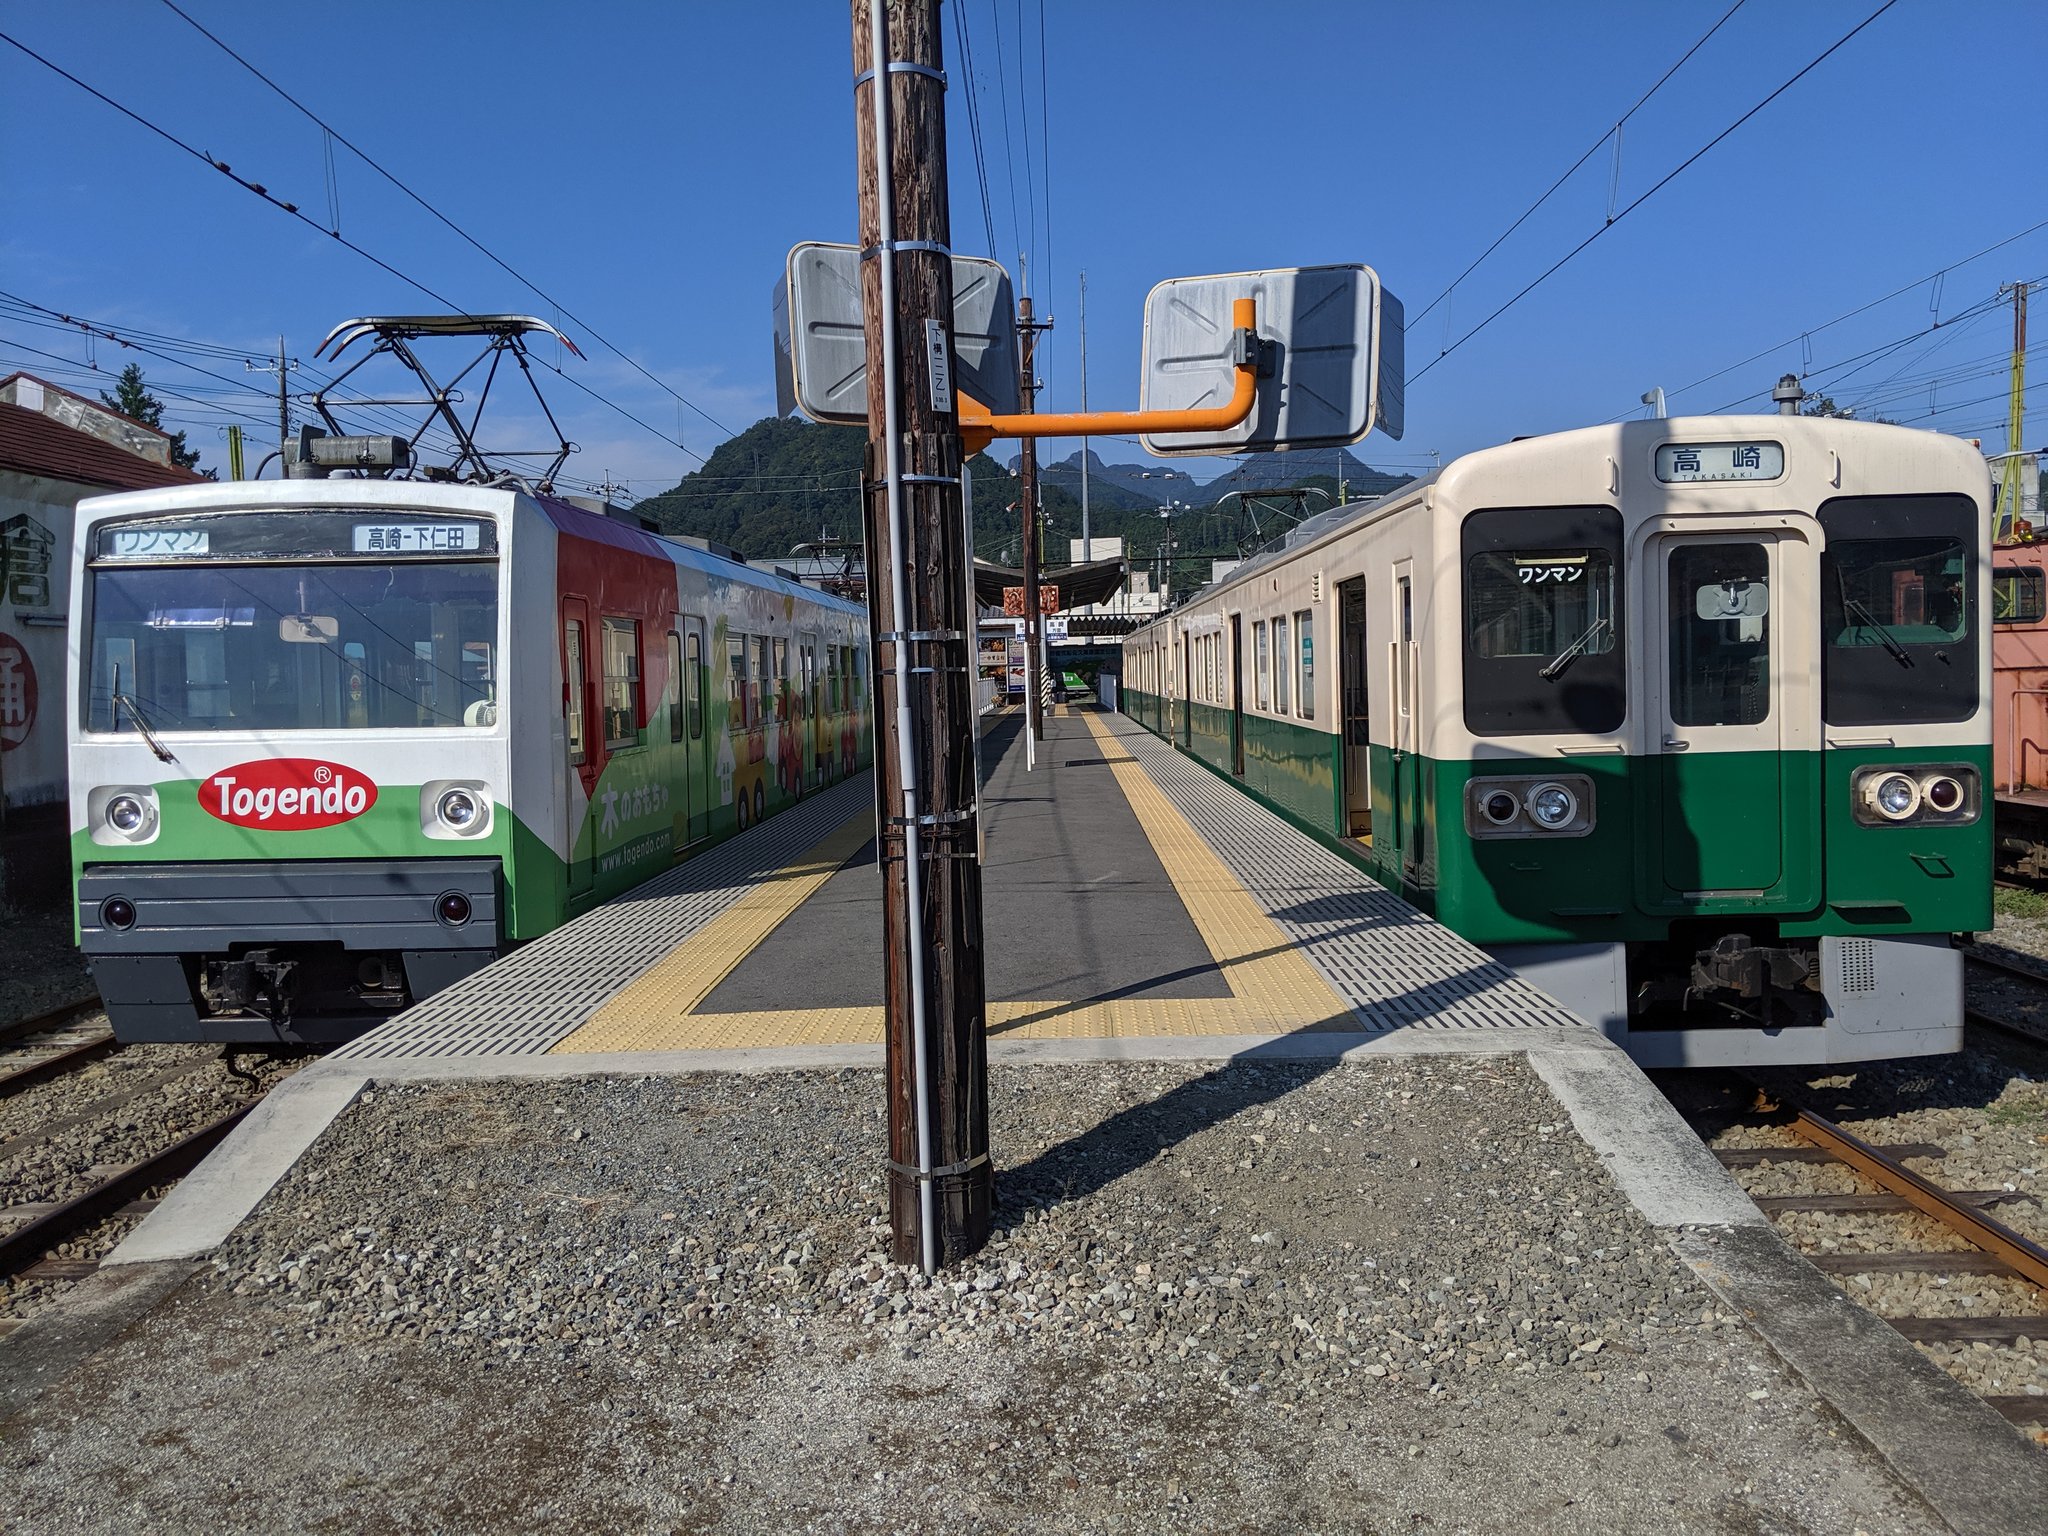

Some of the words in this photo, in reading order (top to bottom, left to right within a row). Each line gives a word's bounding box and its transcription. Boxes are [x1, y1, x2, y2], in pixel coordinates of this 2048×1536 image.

[1672, 446, 1760, 473] 高崎
[1683, 472, 1753, 481] TAKASAKI
[121, 529, 203, 553] ワンマン
[1519, 566, 1583, 584] ワンマン
[214, 774, 367, 821] Togendo
[601, 782, 670, 840] 木のおもちゃ
[601, 832, 672, 873] www.togendo.com
